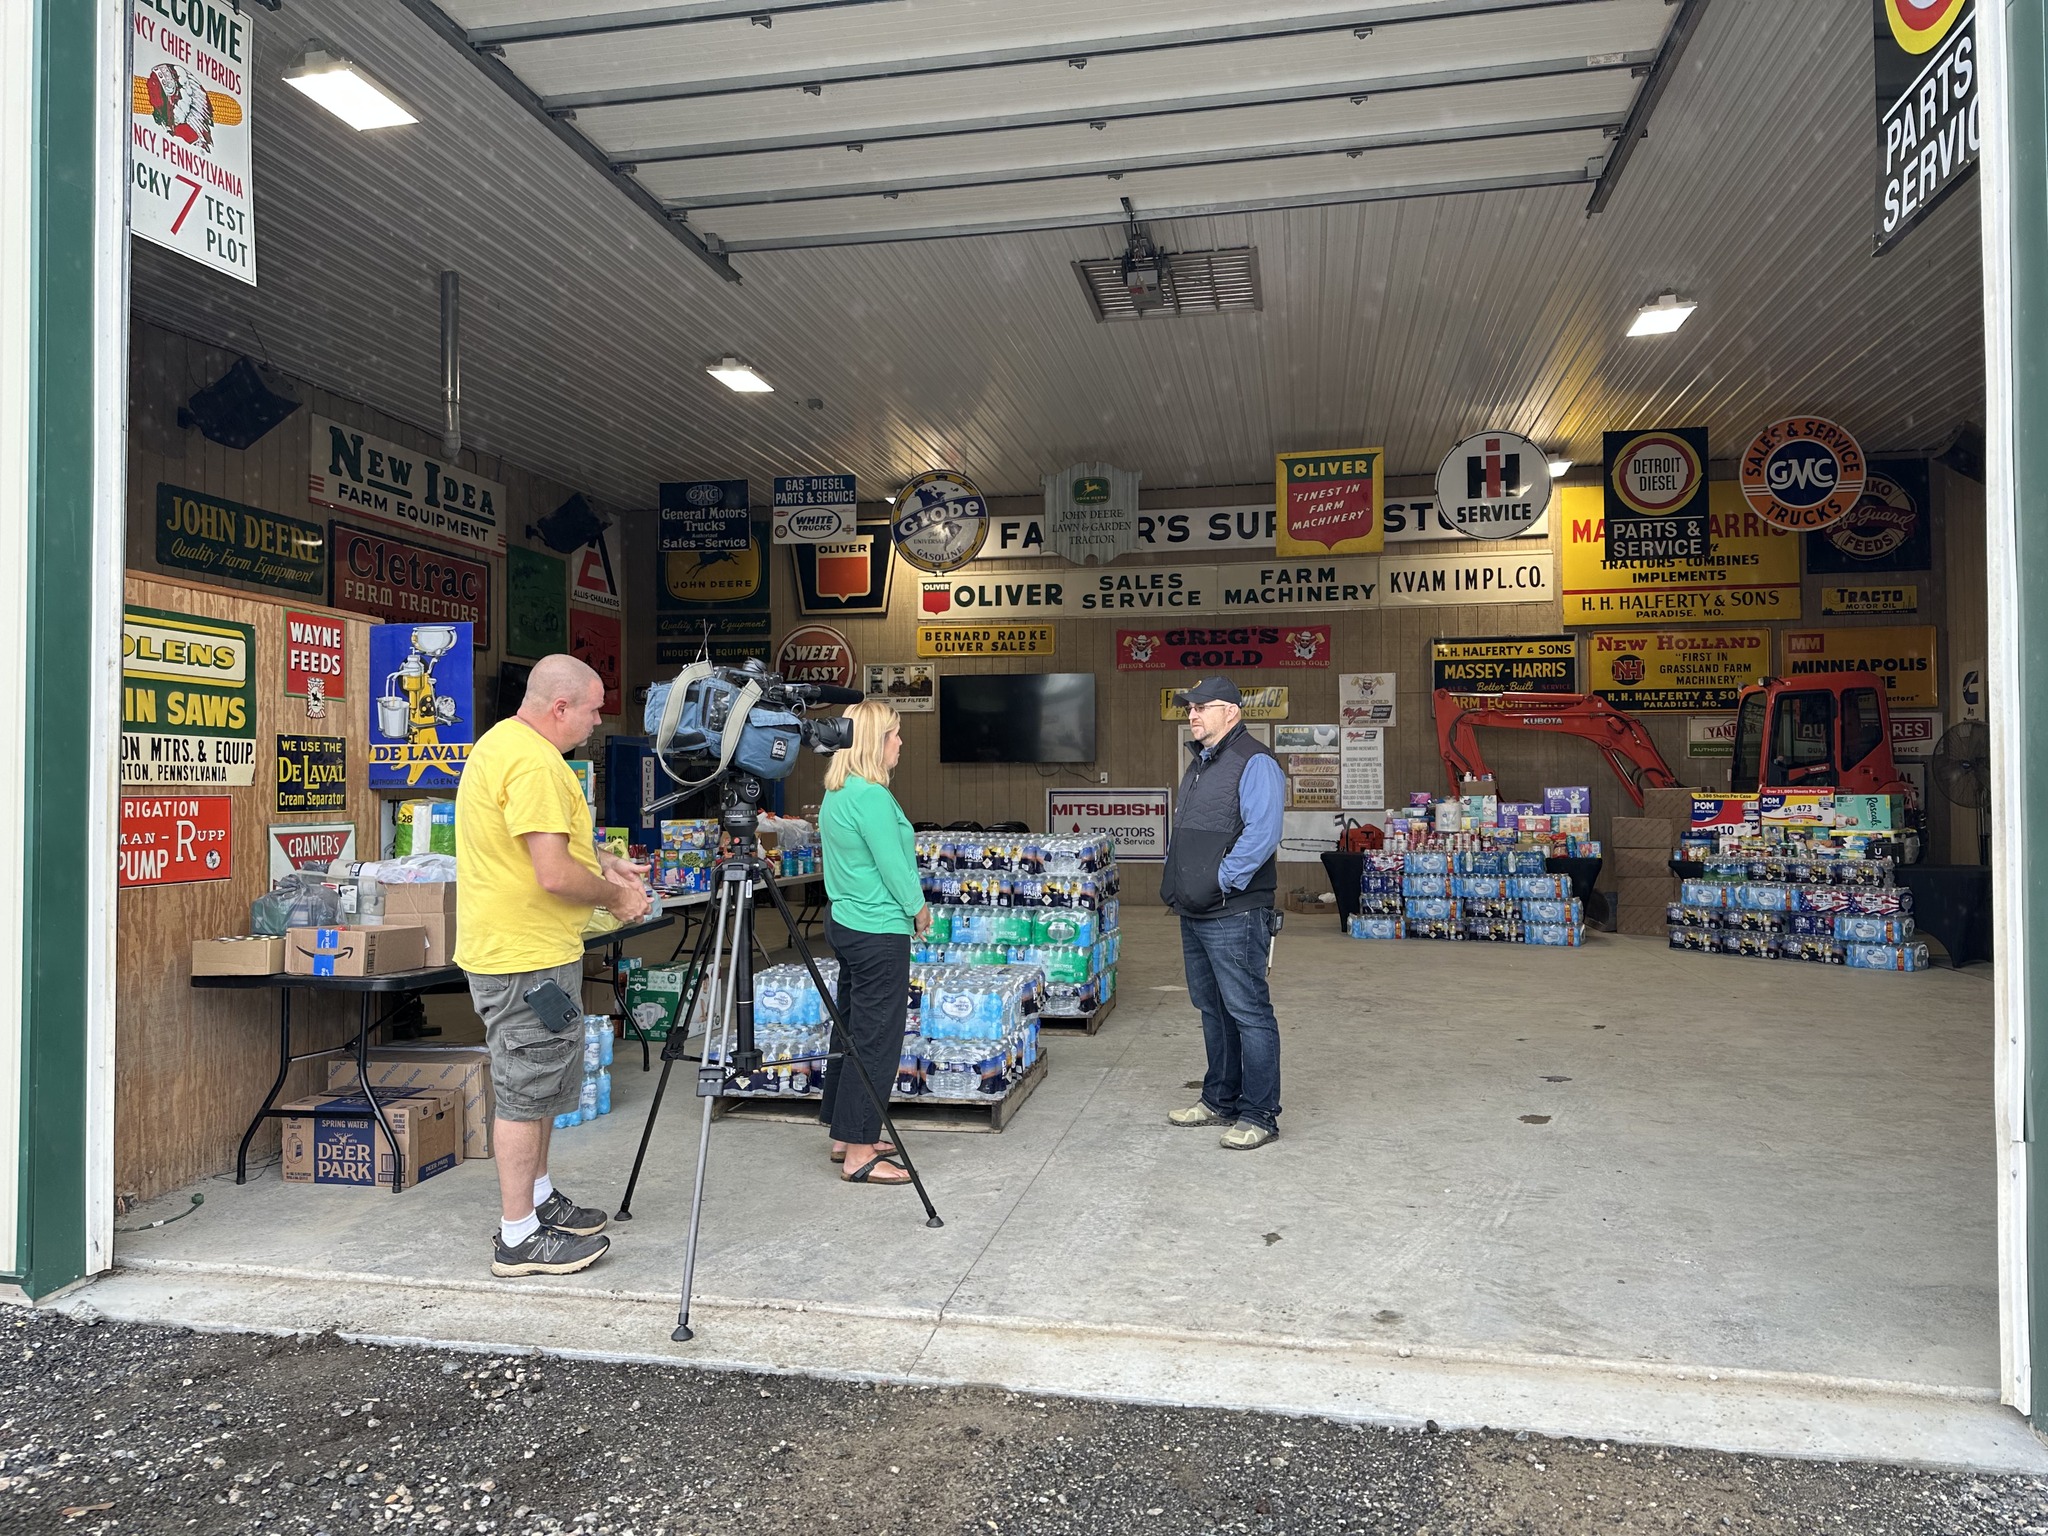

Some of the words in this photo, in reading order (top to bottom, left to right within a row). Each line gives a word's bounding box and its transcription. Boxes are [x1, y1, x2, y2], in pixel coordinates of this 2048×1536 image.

[161, 27, 191, 64] CHIEF
[197, 49, 241, 95] HYBRIDS
[1886, 36, 1973, 176] PARTS
[162, 138, 243, 199] PENNSYLVANIA
[170, 174, 203, 235] 7
[205, 195, 245, 235] TEST
[207, 228, 247, 267] PLOT
[1746, 427, 1783, 477] SALES
[1786, 422, 1799, 438] &
[1803, 421, 1860, 472] SERVICE
[1293, 460, 1368, 477] OLIVER
[1633, 457, 1681, 475] DETROIT
[1769, 458, 1835, 490] GMC
[1639, 474, 1677, 491] DIESEL
[688, 487, 718, 500] GMC
[775, 492, 803, 504] PARTS
[807, 492, 814, 503] &
[817, 490, 854, 503] SERVICE
[1293, 486, 1343, 502] "FINEST
[1345, 483, 1360, 494] IN
[338, 483, 387, 512] FARM
[396, 501, 488, 542] EQUIPMENT
[662, 507, 705, 520] General
[708, 506, 747, 519] Motors
[1060, 510, 1087, 522] JOHN
[1089, 509, 1124, 519] DEERE
[1309, 500, 1345, 514] FARM
[1457, 503, 1532, 523] SERVICE
[1765, 498, 1843, 526] TRUCKS
[683, 520, 725, 531] Trucks
[796, 515, 834, 526] WHITE
[900, 501, 980, 536] Globe
[1291, 507, 1371, 531] MACHINERY"
[1858, 505, 1916, 531] Guard
[166, 496, 236, 544] JOHN
[244, 514, 319, 563] DEERE
[797, 524, 832, 532] TRUCKS
[1052, 522, 1081, 533] LAWN
[1081, 522, 1089, 531] &
[1090, 521, 1132, 532] GARDEN
[1613, 521, 1678, 539] PARTS
[1687, 520, 1701, 537] &
[1069, 534, 1116, 545] TRACTOR
[1843, 534, 1895, 553] FEEDS
[819, 544, 868, 554] OLIVER
[916, 547, 964, 561] GASOLINE
[1613, 539, 1702, 558] SERVICE
[171, 537, 218, 568] Quality
[218, 549, 252, 571] Farm
[253, 556, 315, 583] Equipment
[1686, 554, 1759, 567] COMBINES
[348, 537, 478, 603] Cletrac
[1632, 570, 1727, 584] IMPLEMENTS
[673, 580, 705, 589] JOHN
[710, 579, 752, 588] DEERE
[924, 583, 949, 591] OLIVER
[1099, 573, 1183, 591] SALES
[1261, 567, 1335, 585] FARM
[1390, 569, 1446, 593] KVAM
[344, 579, 394, 606] FARM
[399, 591, 479, 623] TRACTORS
[573, 589, 620, 608] ALLIS-CHALMERS
[954, 583, 1063, 608] OLIVER
[1082, 590, 1201, 609] SERVICE
[1225, 584, 1376, 604] MACHINERY
[1582, 597, 1595, 611] H.
[1600, 596, 1614, 610] H.
[1619, 593, 1711, 610] HALFERTY
[1714, 595, 1726, 607] &
[1731, 590, 1780, 606] SONS
[1837, 588, 1903, 603] TRACTO
[1703, 608, 1724, 616] MO.
[720, 618, 767, 632] Equipment
[290, 622, 341, 649] WAYNE
[925, 632, 990, 641] BERNARD
[998, 630, 1047, 640] RADKE
[1164, 628, 1279, 646] GREG'S
[1596, 636, 1648, 652] NEW
[1656, 635, 1761, 650] HOLLAND
[1791, 637, 1821, 650] MM
[716, 647, 766, 656] EQUIPMENT
[784, 643, 843, 661] SWEET
[935, 642, 983, 652] OLIVER
[991, 642, 1036, 651] SALES
[1463, 645, 1523, 657] HALFERTY
[1527, 646, 1534, 654] &
[1538, 644, 1572, 654] SONS
[290, 650, 341, 676] FEEDS
[1180, 650, 1263, 667] GOLD
[1717, 652, 1728, 661] IN
[787, 666, 846, 682] LASSY
[1444, 662, 1567, 679] MASSEY-HARRIS
[1659, 664, 1719, 674] GRASSLAND
[1724, 663, 1752, 673] FARM
[1791, 657, 1927, 674] MINNEAPOLIS
[1676, 674, 1743, 685] MACHINERY"
[1635, 692, 1700, 701] HALFERTY
[1705, 691, 1714, 700] &
[167, 691, 246, 730] SAWS
[1523, 717, 1564, 725] KUBOTA
[151, 737, 194, 762] MTRS.
[198, 740, 207, 762] &
[216, 741, 254, 764] EQUIP.
[281, 740, 297, 752] WE
[301, 741, 320, 752] USE
[324, 742, 342, 753] THE
[375, 747, 401, 761] DE
[407, 746, 468, 761] LAVAL
[158, 764, 227, 782] PENNSYLVANIA
[279, 792, 305, 806] Cream
[307, 793, 345, 807] Separator
[1694, 801, 1714, 810] POM
[124, 800, 199, 818] RIGATION
[1052, 804, 1165, 816] MITSUBISHI
[1865, 797, 1882, 827] Rascals
[401, 814, 413, 823] 28
[1714, 825, 1734, 835] 110
[288, 834, 340, 858] CRAMER'S
[1123, 837, 1155, 845] Service
[423, 1106, 428, 1116] 6
[321, 1119, 346, 1128] SPRING
[347, 1120, 369, 1129] WATER
[317, 1142, 371, 1161] DEER
[317, 1161, 373, 1182] PARK
